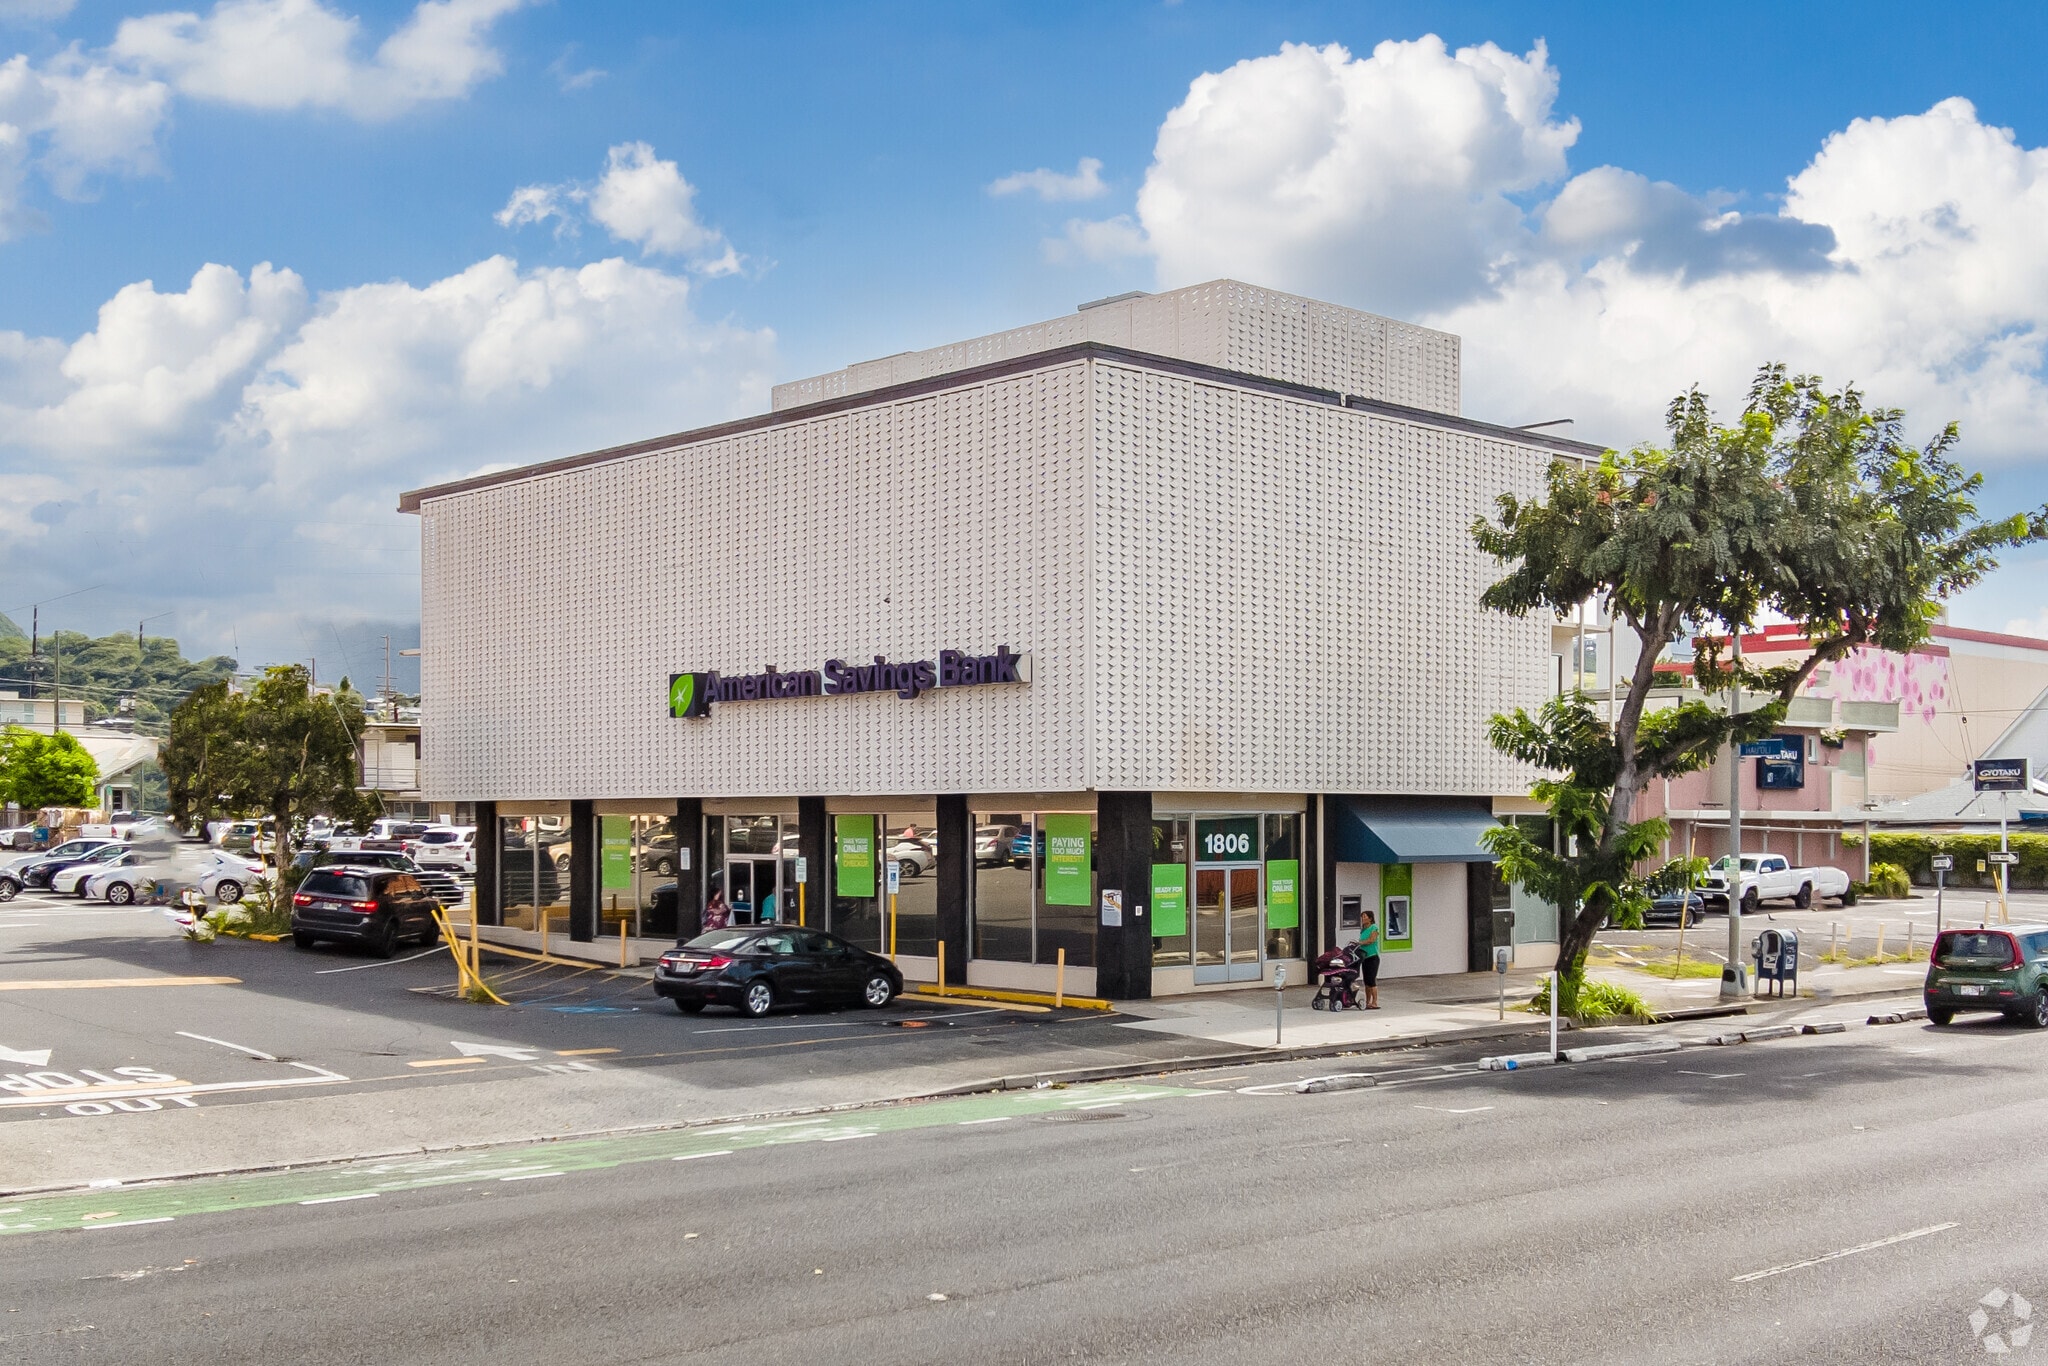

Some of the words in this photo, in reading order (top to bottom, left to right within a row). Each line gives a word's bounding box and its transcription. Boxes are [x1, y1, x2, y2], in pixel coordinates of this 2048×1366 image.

[702, 664, 821, 702] American
[824, 655, 937, 700] Savings
[939, 645, 1021, 687] Bank
[1979, 768, 2021, 777] GYOTAKU
[843, 844, 869, 853] ONLINE
[1051, 837, 1084, 848] PAYING
[1205, 833, 1250, 854] 1806
[65, 1094, 199, 1116] OUT
